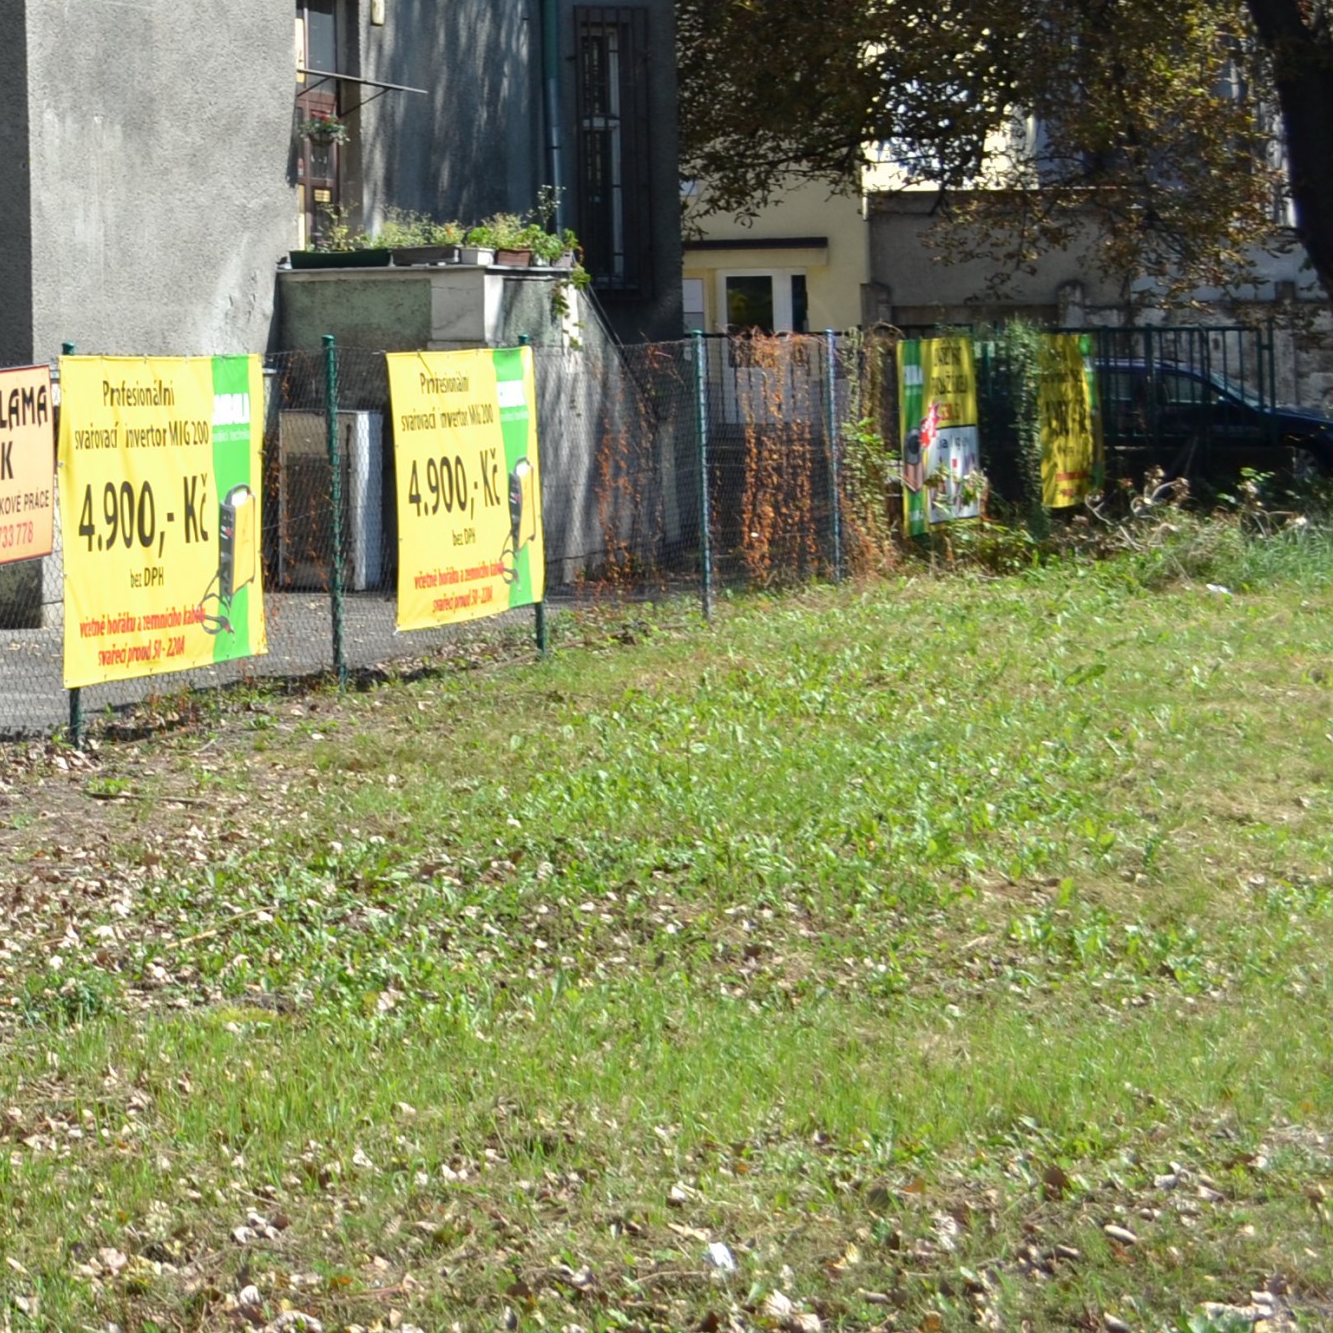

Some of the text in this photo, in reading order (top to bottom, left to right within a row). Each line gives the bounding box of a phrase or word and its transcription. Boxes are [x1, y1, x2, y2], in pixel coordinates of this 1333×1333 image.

[125, 423, 167, 448] invertor
[169, 420, 190, 447] MIG
[193, 420, 209, 445] 200
[409, 448, 501, 520] 4.900,- Kč
[24, 487, 50, 510] PRÁCE
[78, 473, 209, 559] 4.900,- Kč
[16, 521, 34, 545] 778
[130, 566, 164, 588] bez DPH
